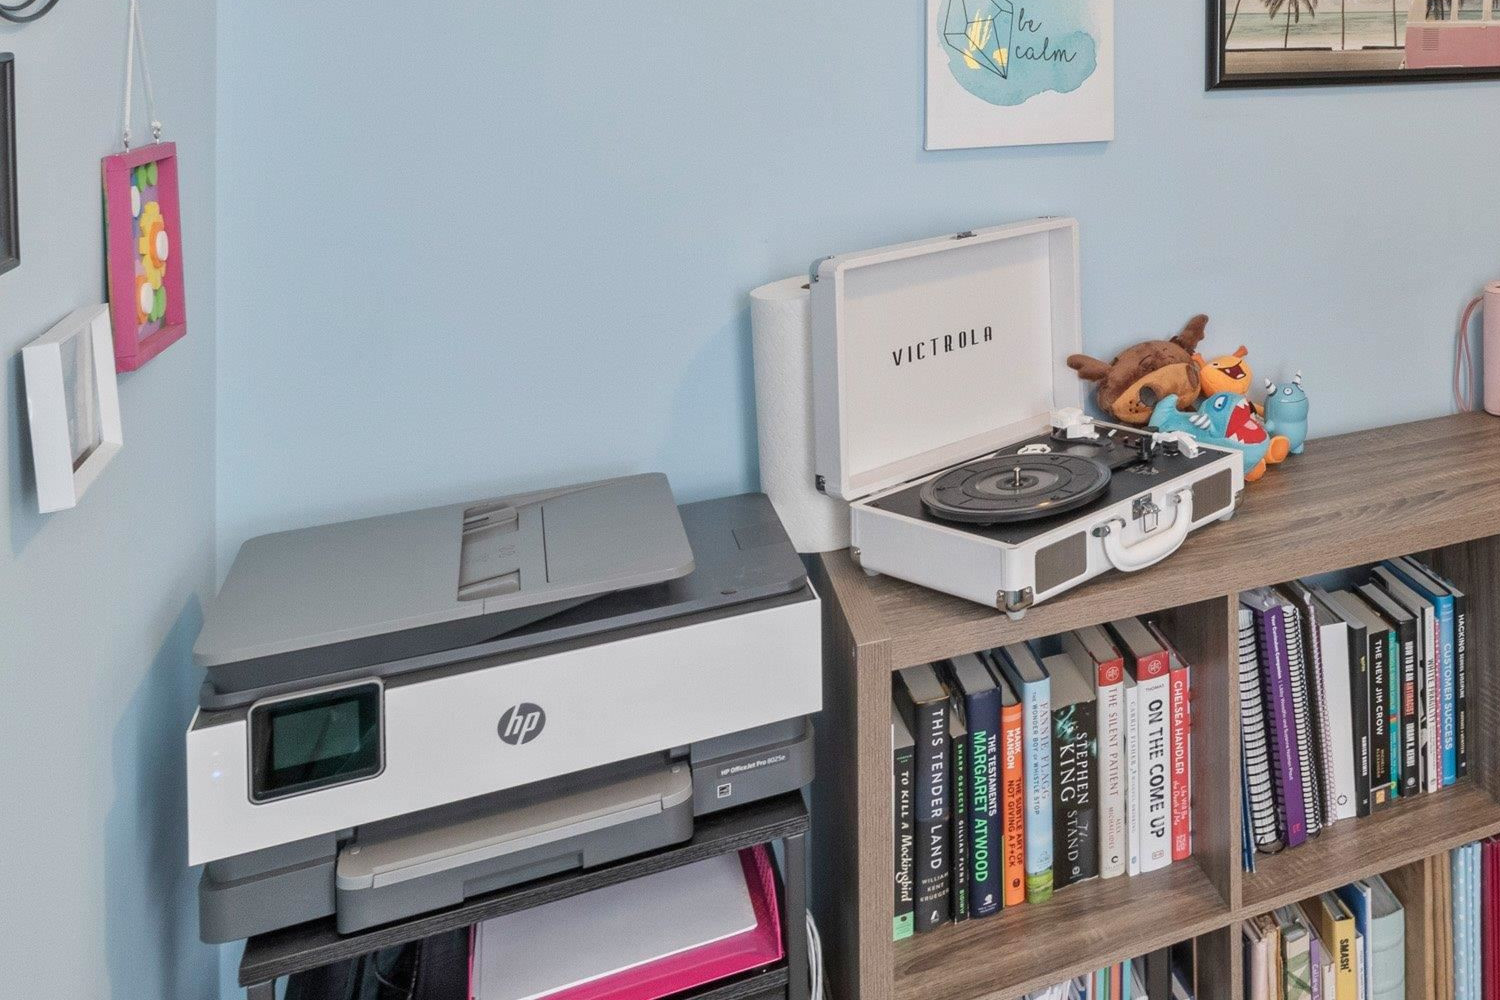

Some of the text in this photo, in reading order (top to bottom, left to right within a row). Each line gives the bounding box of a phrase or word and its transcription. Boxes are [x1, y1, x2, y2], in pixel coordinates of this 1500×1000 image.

[1018, 8, 1042, 32] be
[1015, 37, 1077, 62] calm
[892, 326, 992, 366] VICTROLA
[1405, 641, 1413, 656] HOW
[1405, 656, 1413, 664] TO
[1375, 661, 1383, 684] NEW
[1405, 664, 1413, 673] BE
[1406, 673, 1413, 681] AN
[1375, 687, 1383, 703] JIM
[1405, 682, 1414, 716] ANTIRACIST
[1443, 643, 1453, 750] CUSTOMER SUCCESS
[502, 703, 542, 745] hp
[1174, 680, 1184, 775] CHELSEA HANDLER
[1375, 705, 1383, 735] CROW
[1406, 723, 1415, 741] IBRAM
[1006, 729, 1015, 769] MANSON
[1039, 703, 1050, 799] FANNIE FLAGG
[1109, 687, 1118, 796] THE SILENT PATIENT
[757, 759, 767, 767] Pro
[1060, 743, 1075, 802] KING
[1076, 731, 1089, 804] STEPHEN
[1149, 699, 1165, 838] ON THE COME UP
[1406, 749, 1415, 767] KENDI
[930, 708, 944, 869] THIS TENDER LAND
[987, 734, 997, 817] THE TESTAMENTS
[974, 730, 988, 882] MARGARET ATWOOD
[895, 770, 912, 902] TO KILL A Mockingbird
[1009, 834, 1015, 843] A
[1067, 810, 1079, 861] STAND
[1017, 852, 1023, 866] OF
[922, 871, 949, 885] WILLIAM
[926, 882, 945, 892] KENT
[920, 888, 949, 902] KRUEGER
